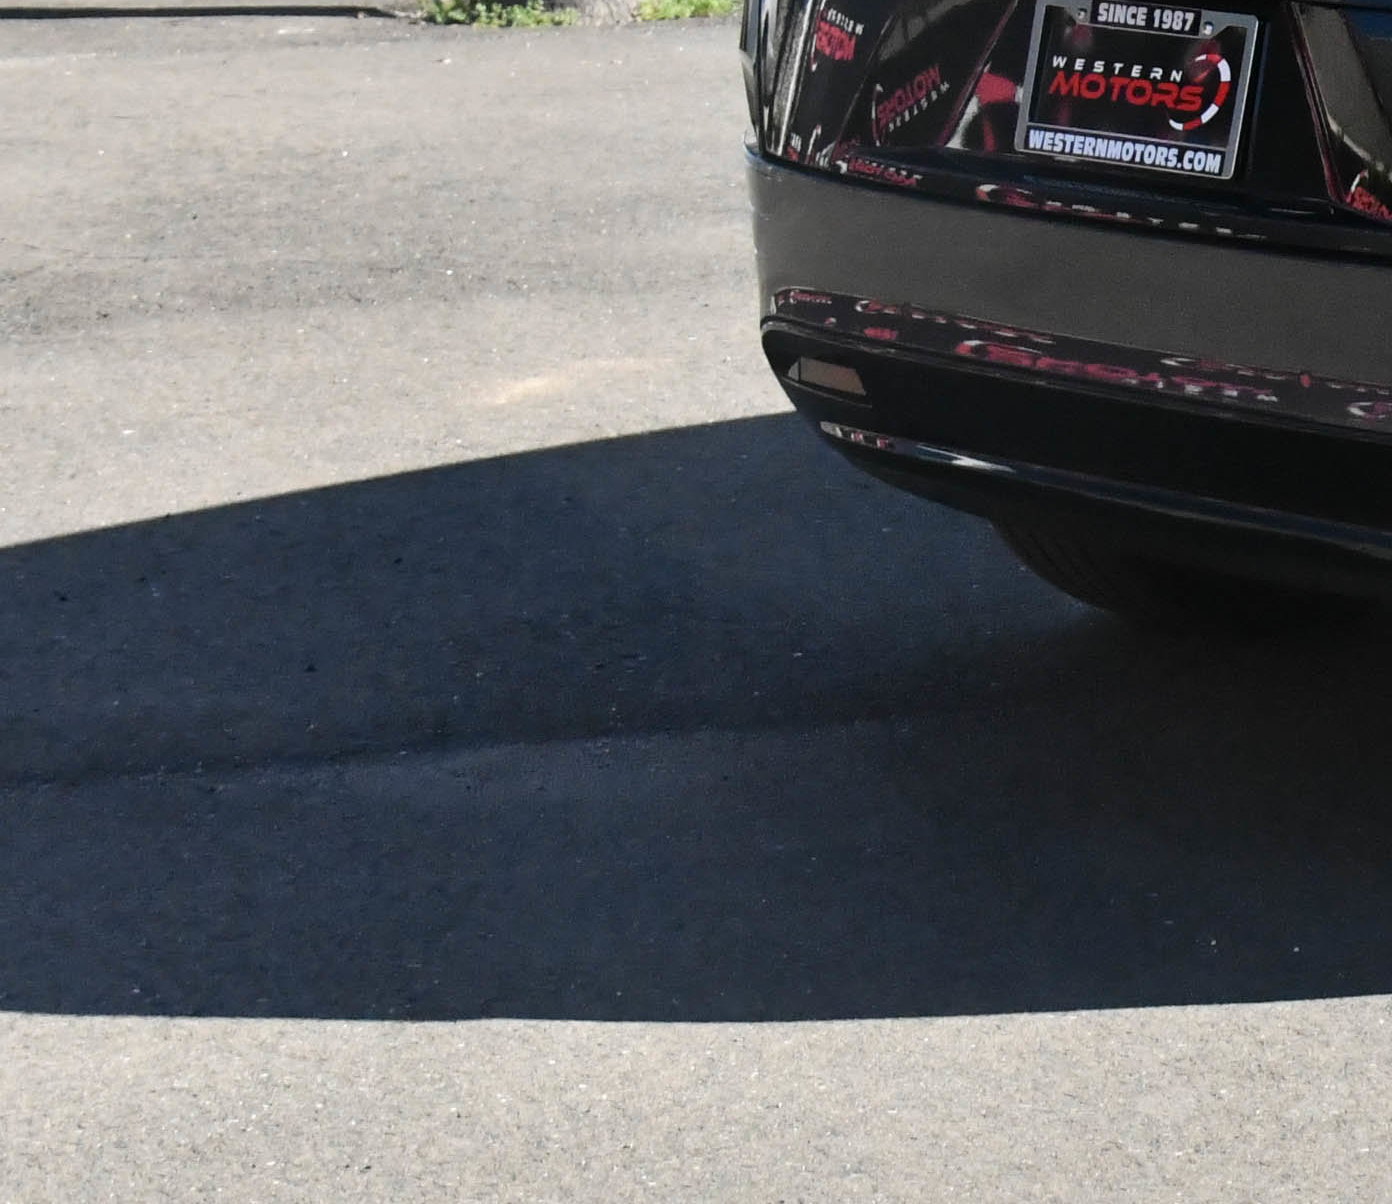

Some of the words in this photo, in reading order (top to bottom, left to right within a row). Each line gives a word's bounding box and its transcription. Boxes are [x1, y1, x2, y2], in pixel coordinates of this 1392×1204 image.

[1097, 2, 1148, 27] SINCE
[1153, 9, 1195, 32] 1987
[1052, 55, 1183, 82] WESTERN
[1048, 70, 1204, 112] MOTORS
[1029, 129, 1222, 174] WESTERNMOTORS.COM
